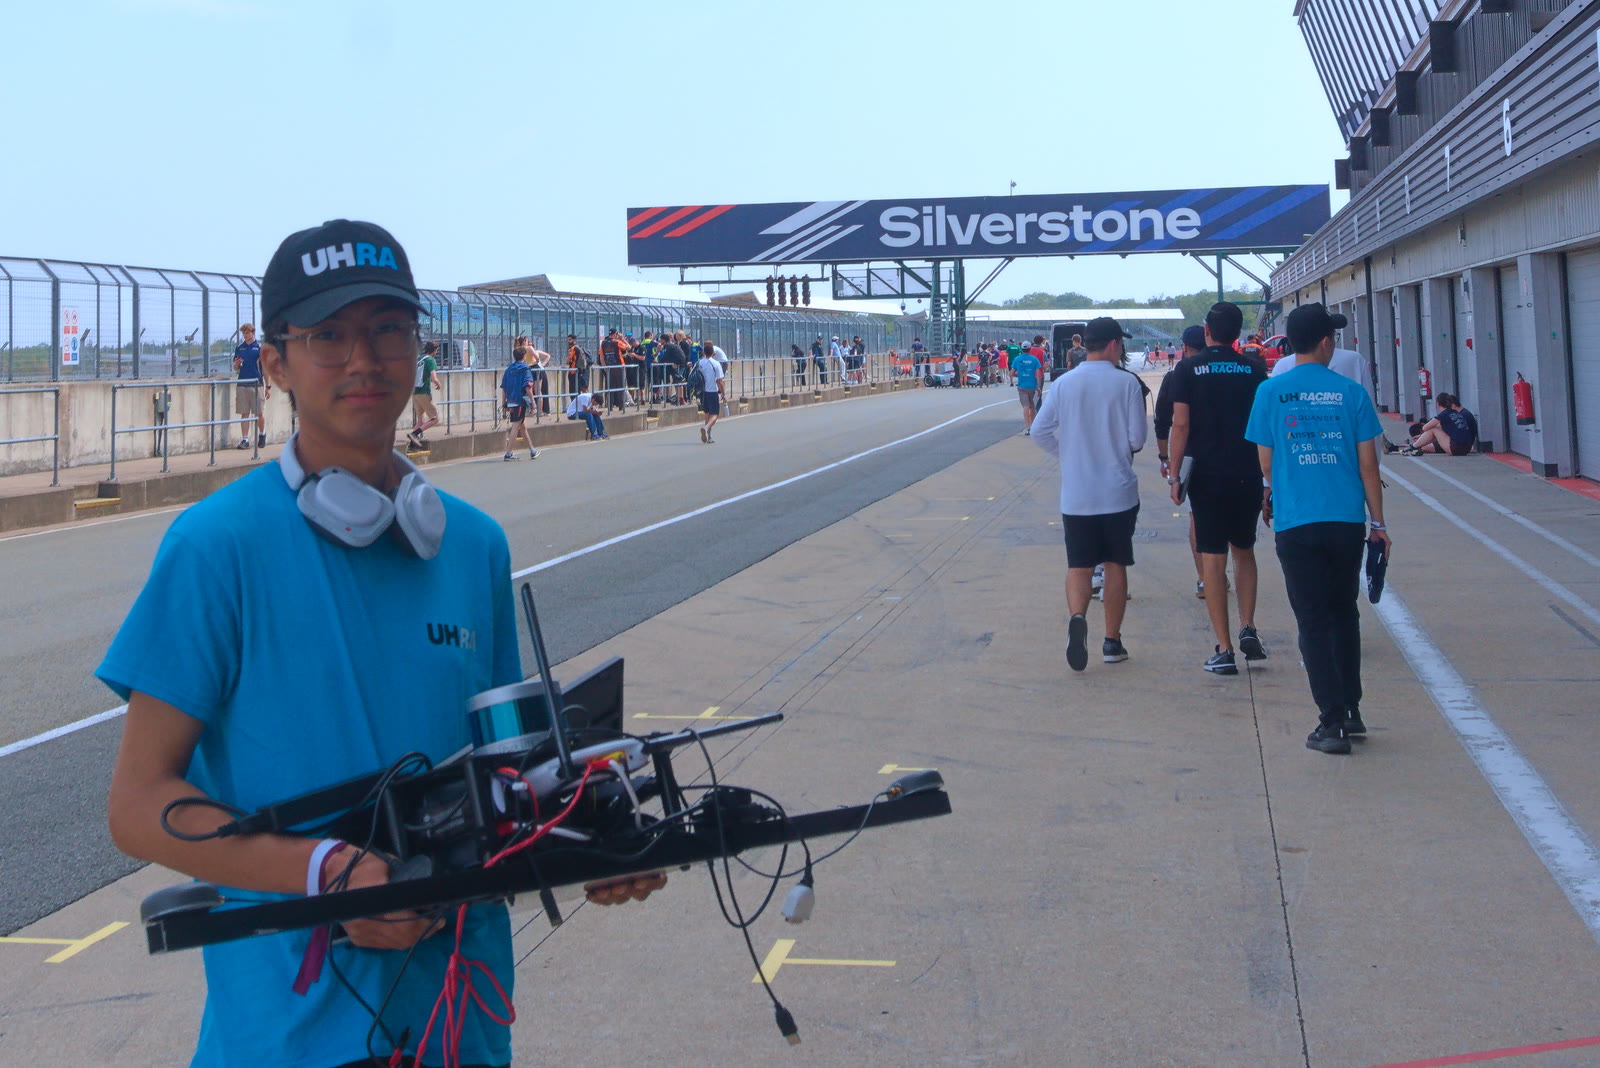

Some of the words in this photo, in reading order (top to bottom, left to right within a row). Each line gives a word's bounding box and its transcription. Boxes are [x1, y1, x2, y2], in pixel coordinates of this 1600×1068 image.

[1503, 98, 1512, 157] 6
[879, 204, 1201, 248] Silverstone
[301, 242, 398, 277] UHRA
[1211, 365, 1252, 374] RACING
